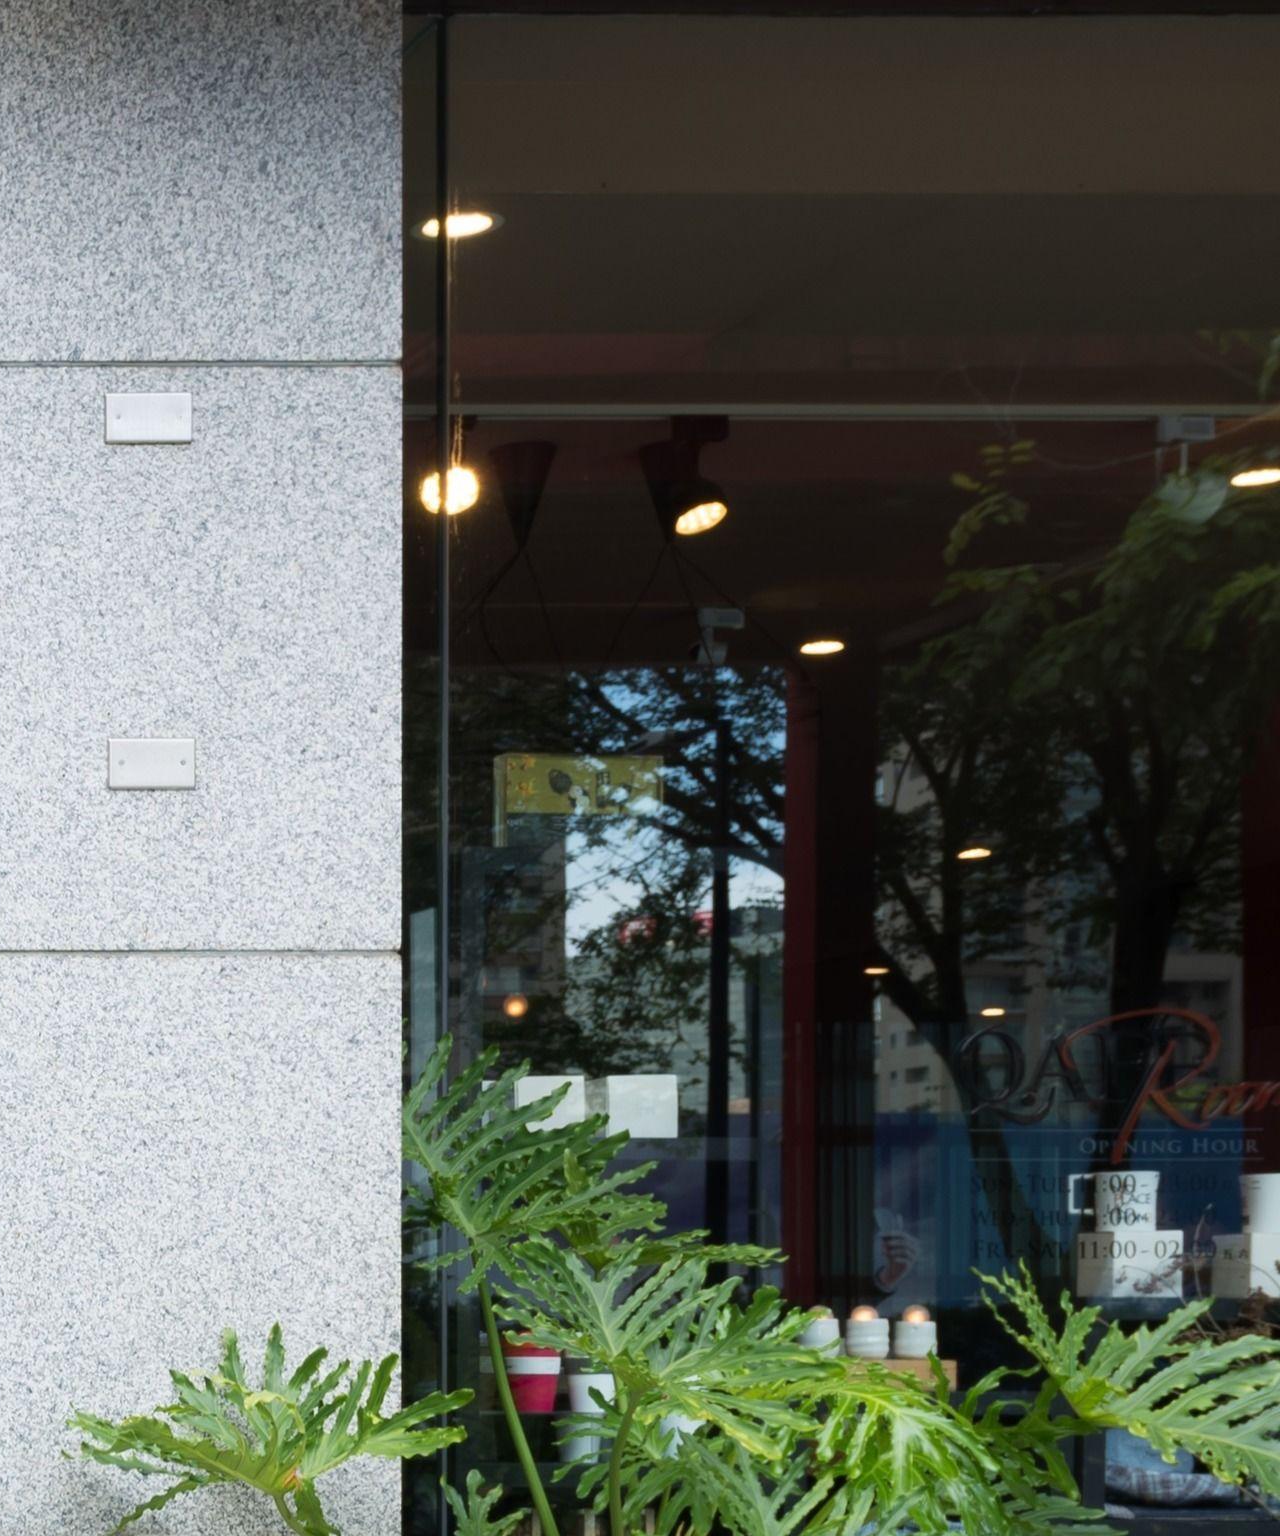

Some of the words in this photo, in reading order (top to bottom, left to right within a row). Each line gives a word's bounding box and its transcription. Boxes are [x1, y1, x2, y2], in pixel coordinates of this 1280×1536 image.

[1079, 1136, 1182, 1155] OPNING
[1192, 1136, 1259, 1155] HOUR
[1078, 1239, 1217, 1259] 11:00-0200
